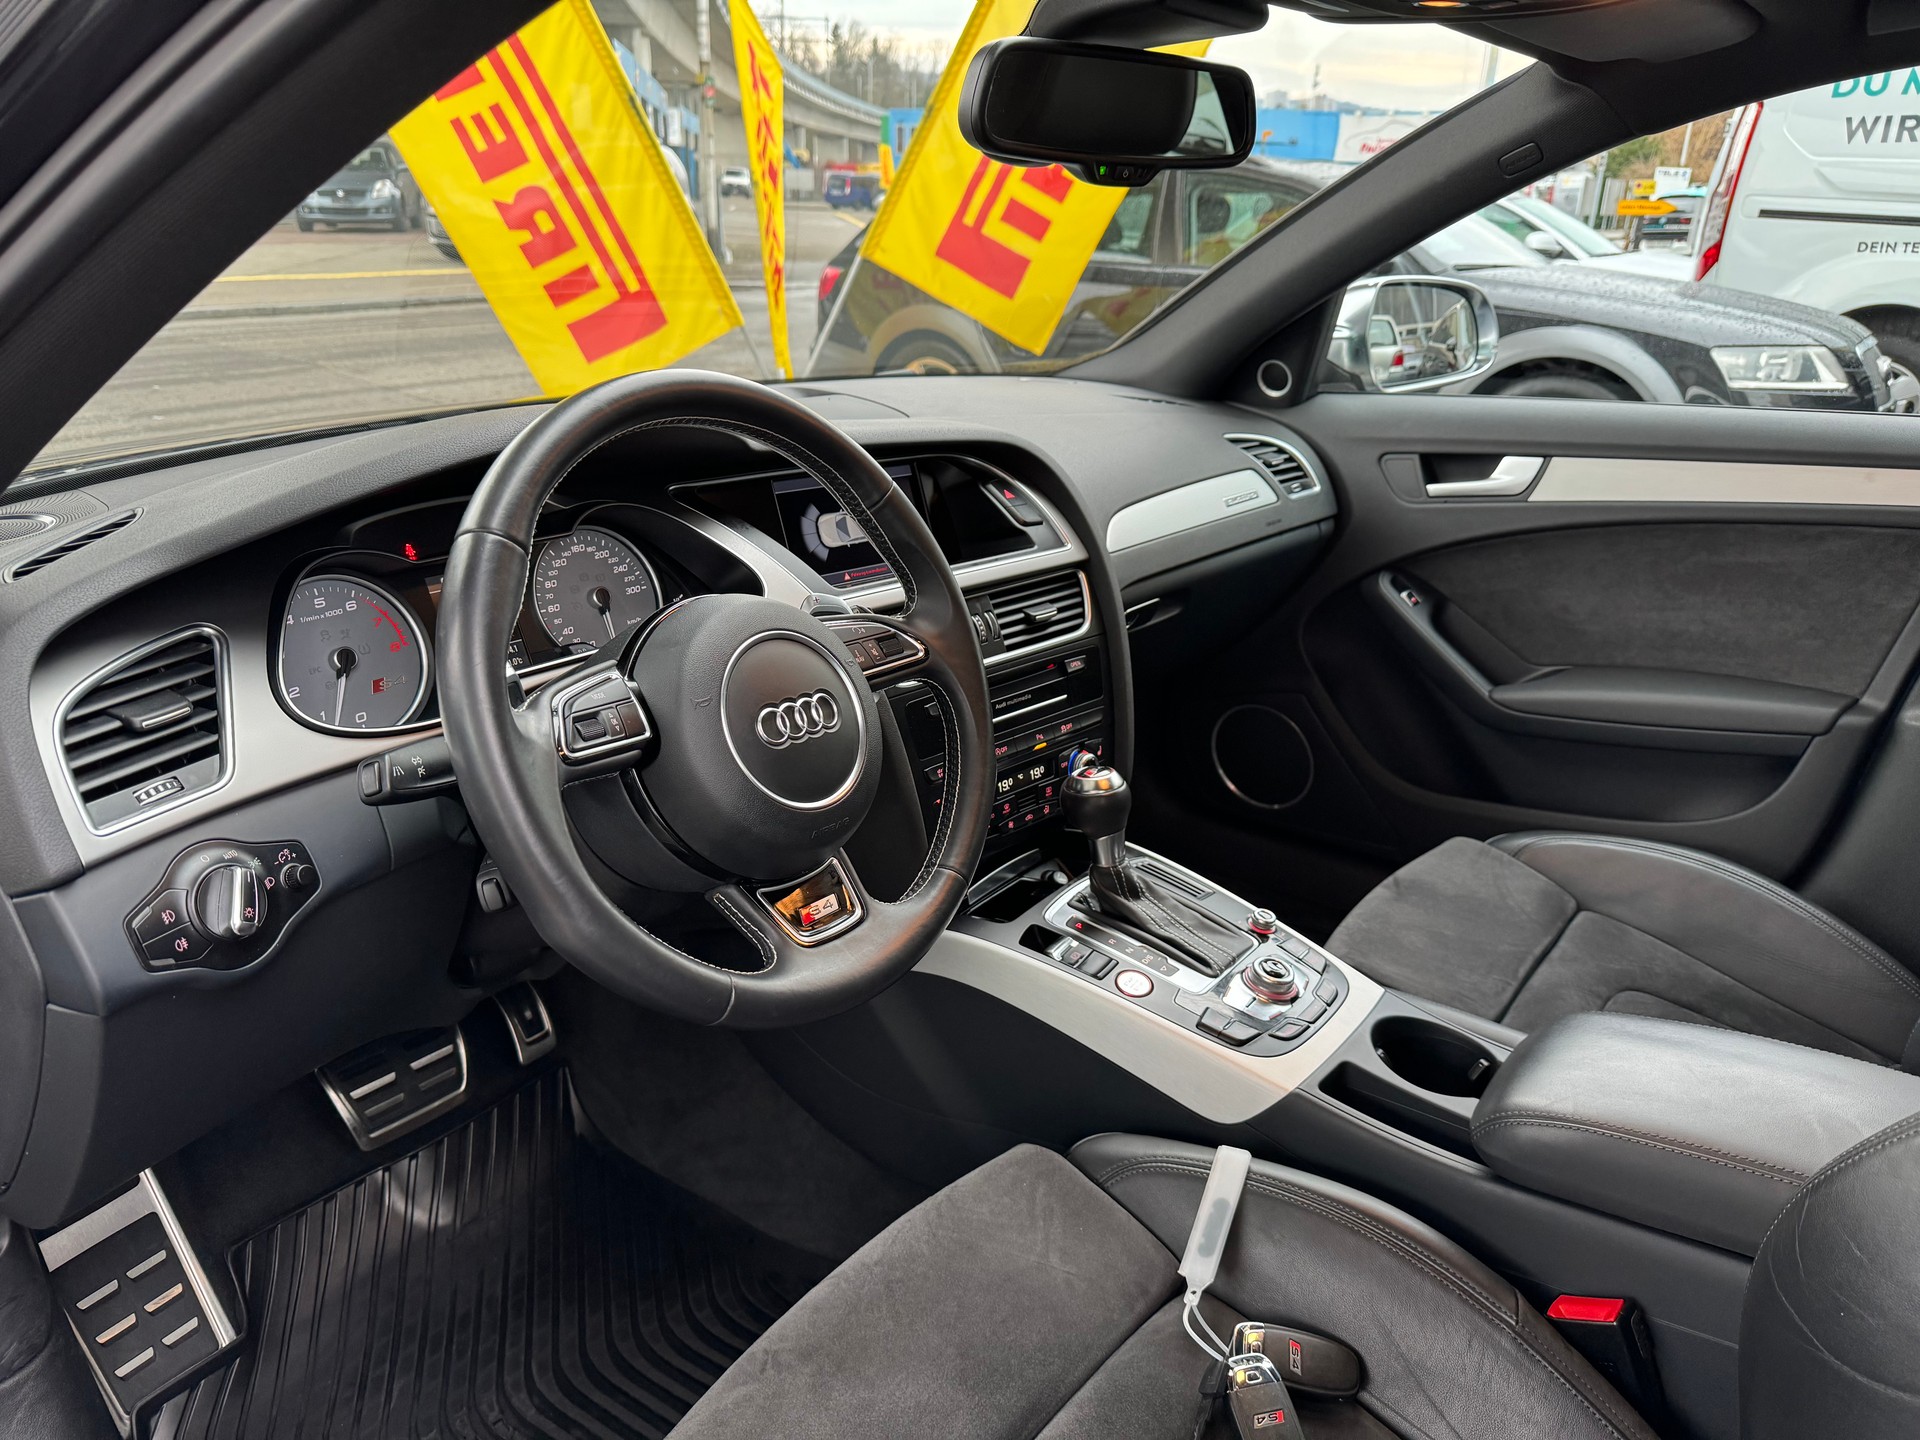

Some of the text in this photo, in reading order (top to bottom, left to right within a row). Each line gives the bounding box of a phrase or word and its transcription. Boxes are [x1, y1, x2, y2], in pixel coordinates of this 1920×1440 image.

[1831, 71, 1891, 98] DU
[1846, 114, 1920, 144] WIR
[1857, 241, 1898, 254] DEIN
[571, 544, 585, 552] 160
[594, 550, 609, 560] 200
[607, 556, 619, 564] 220
[552, 558, 567, 568] 120
[548, 569, 559, 577] 100
[613, 564, 628, 574] 240
[545, 580, 557, 589] 80
[624, 575, 636, 583] 270
[625, 585, 641, 595] 300
[314, 597, 326, 609] 5
[345, 600, 357, 612] 6
[548, 603, 560, 613] 60
[372, 617, 382, 629] 7
[562, 627, 574, 635] 40
[288, 686, 301, 699] 2
[320, 710, 327, 721] 1
[355, 711, 367, 723] 0
[222, 849, 238, 860] AUTO
[1291, 1346, 1300, 1370] S4
[1256, 1412, 1279, 1425] S4
